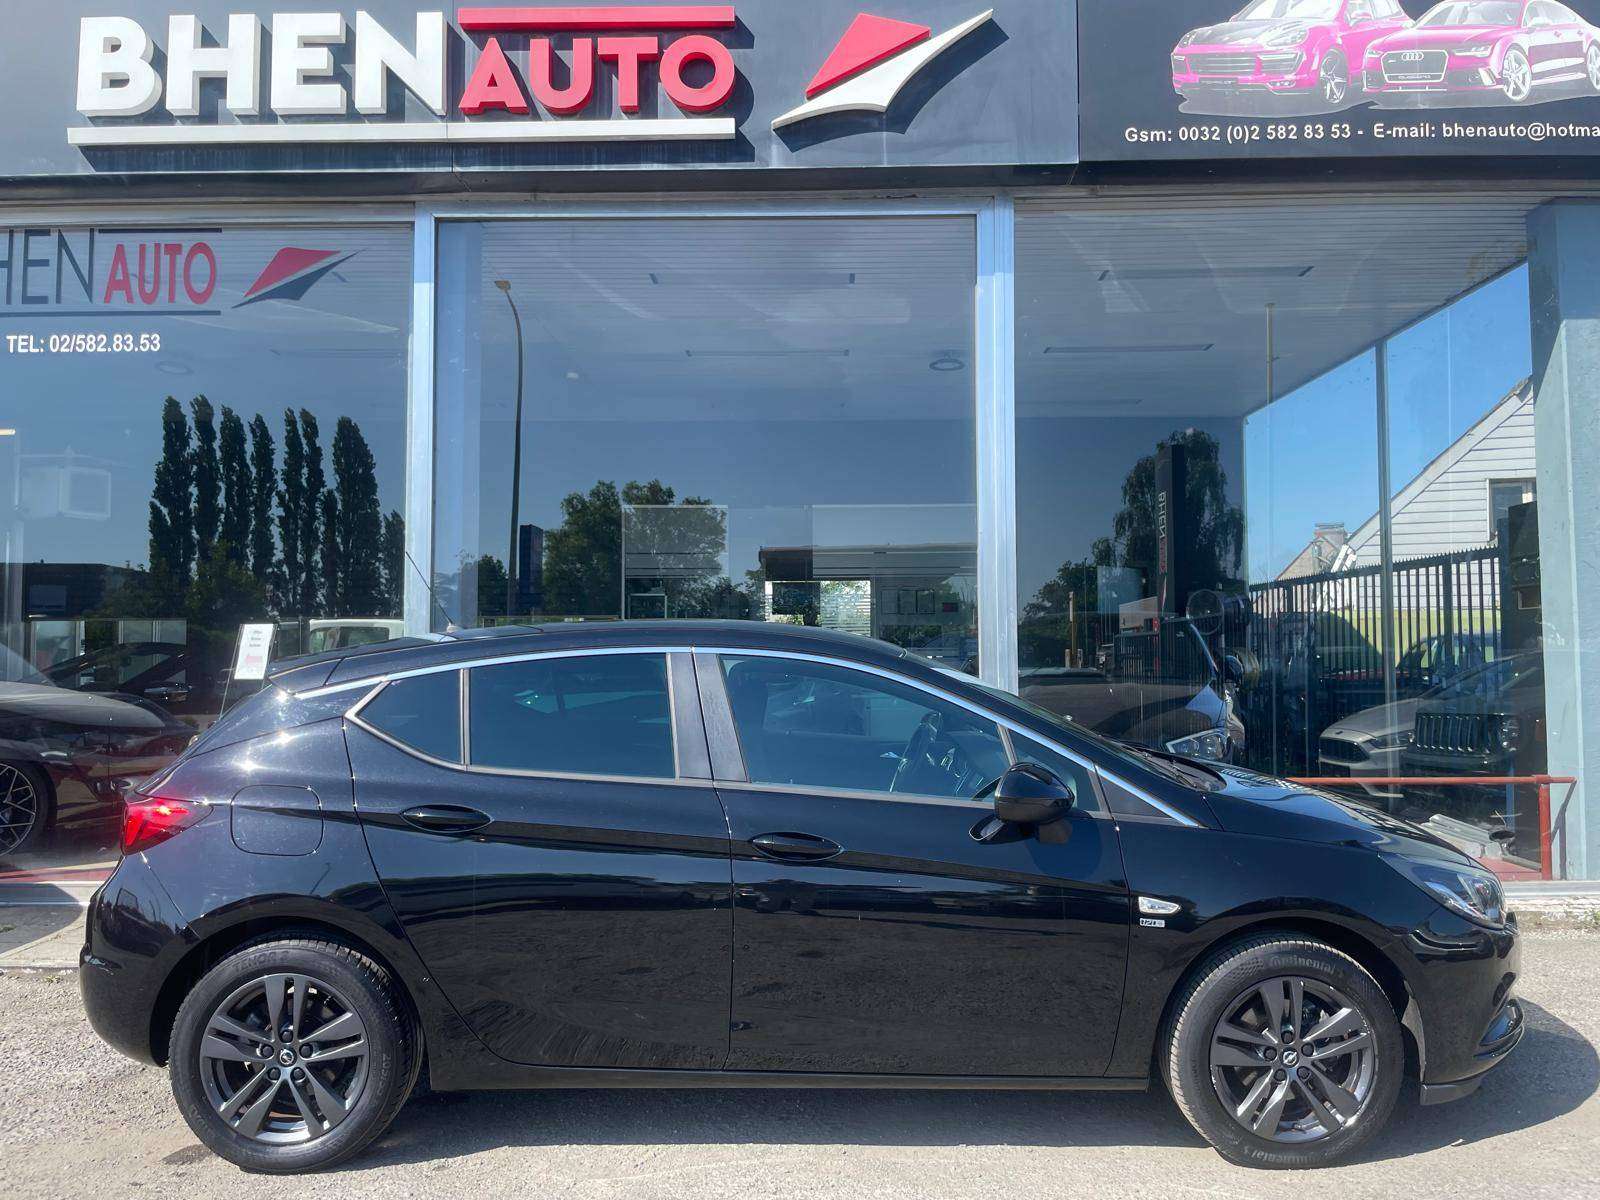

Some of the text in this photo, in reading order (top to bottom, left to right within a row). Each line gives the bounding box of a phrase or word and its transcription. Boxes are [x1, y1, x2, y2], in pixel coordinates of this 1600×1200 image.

[1124, 127, 1172, 142] Gsm:
[1178, 126, 1221, 141] 0032
[1226, 124, 1260, 144] (0)2
[1266, 124, 1298, 140] 582
[1303, 124, 1325, 139] 83
[1330, 123, 1351, 139] 53
[1373, 123, 1436, 138] E-mail:
[6, 333, 161, 353] TEL: 02/582.83.53
